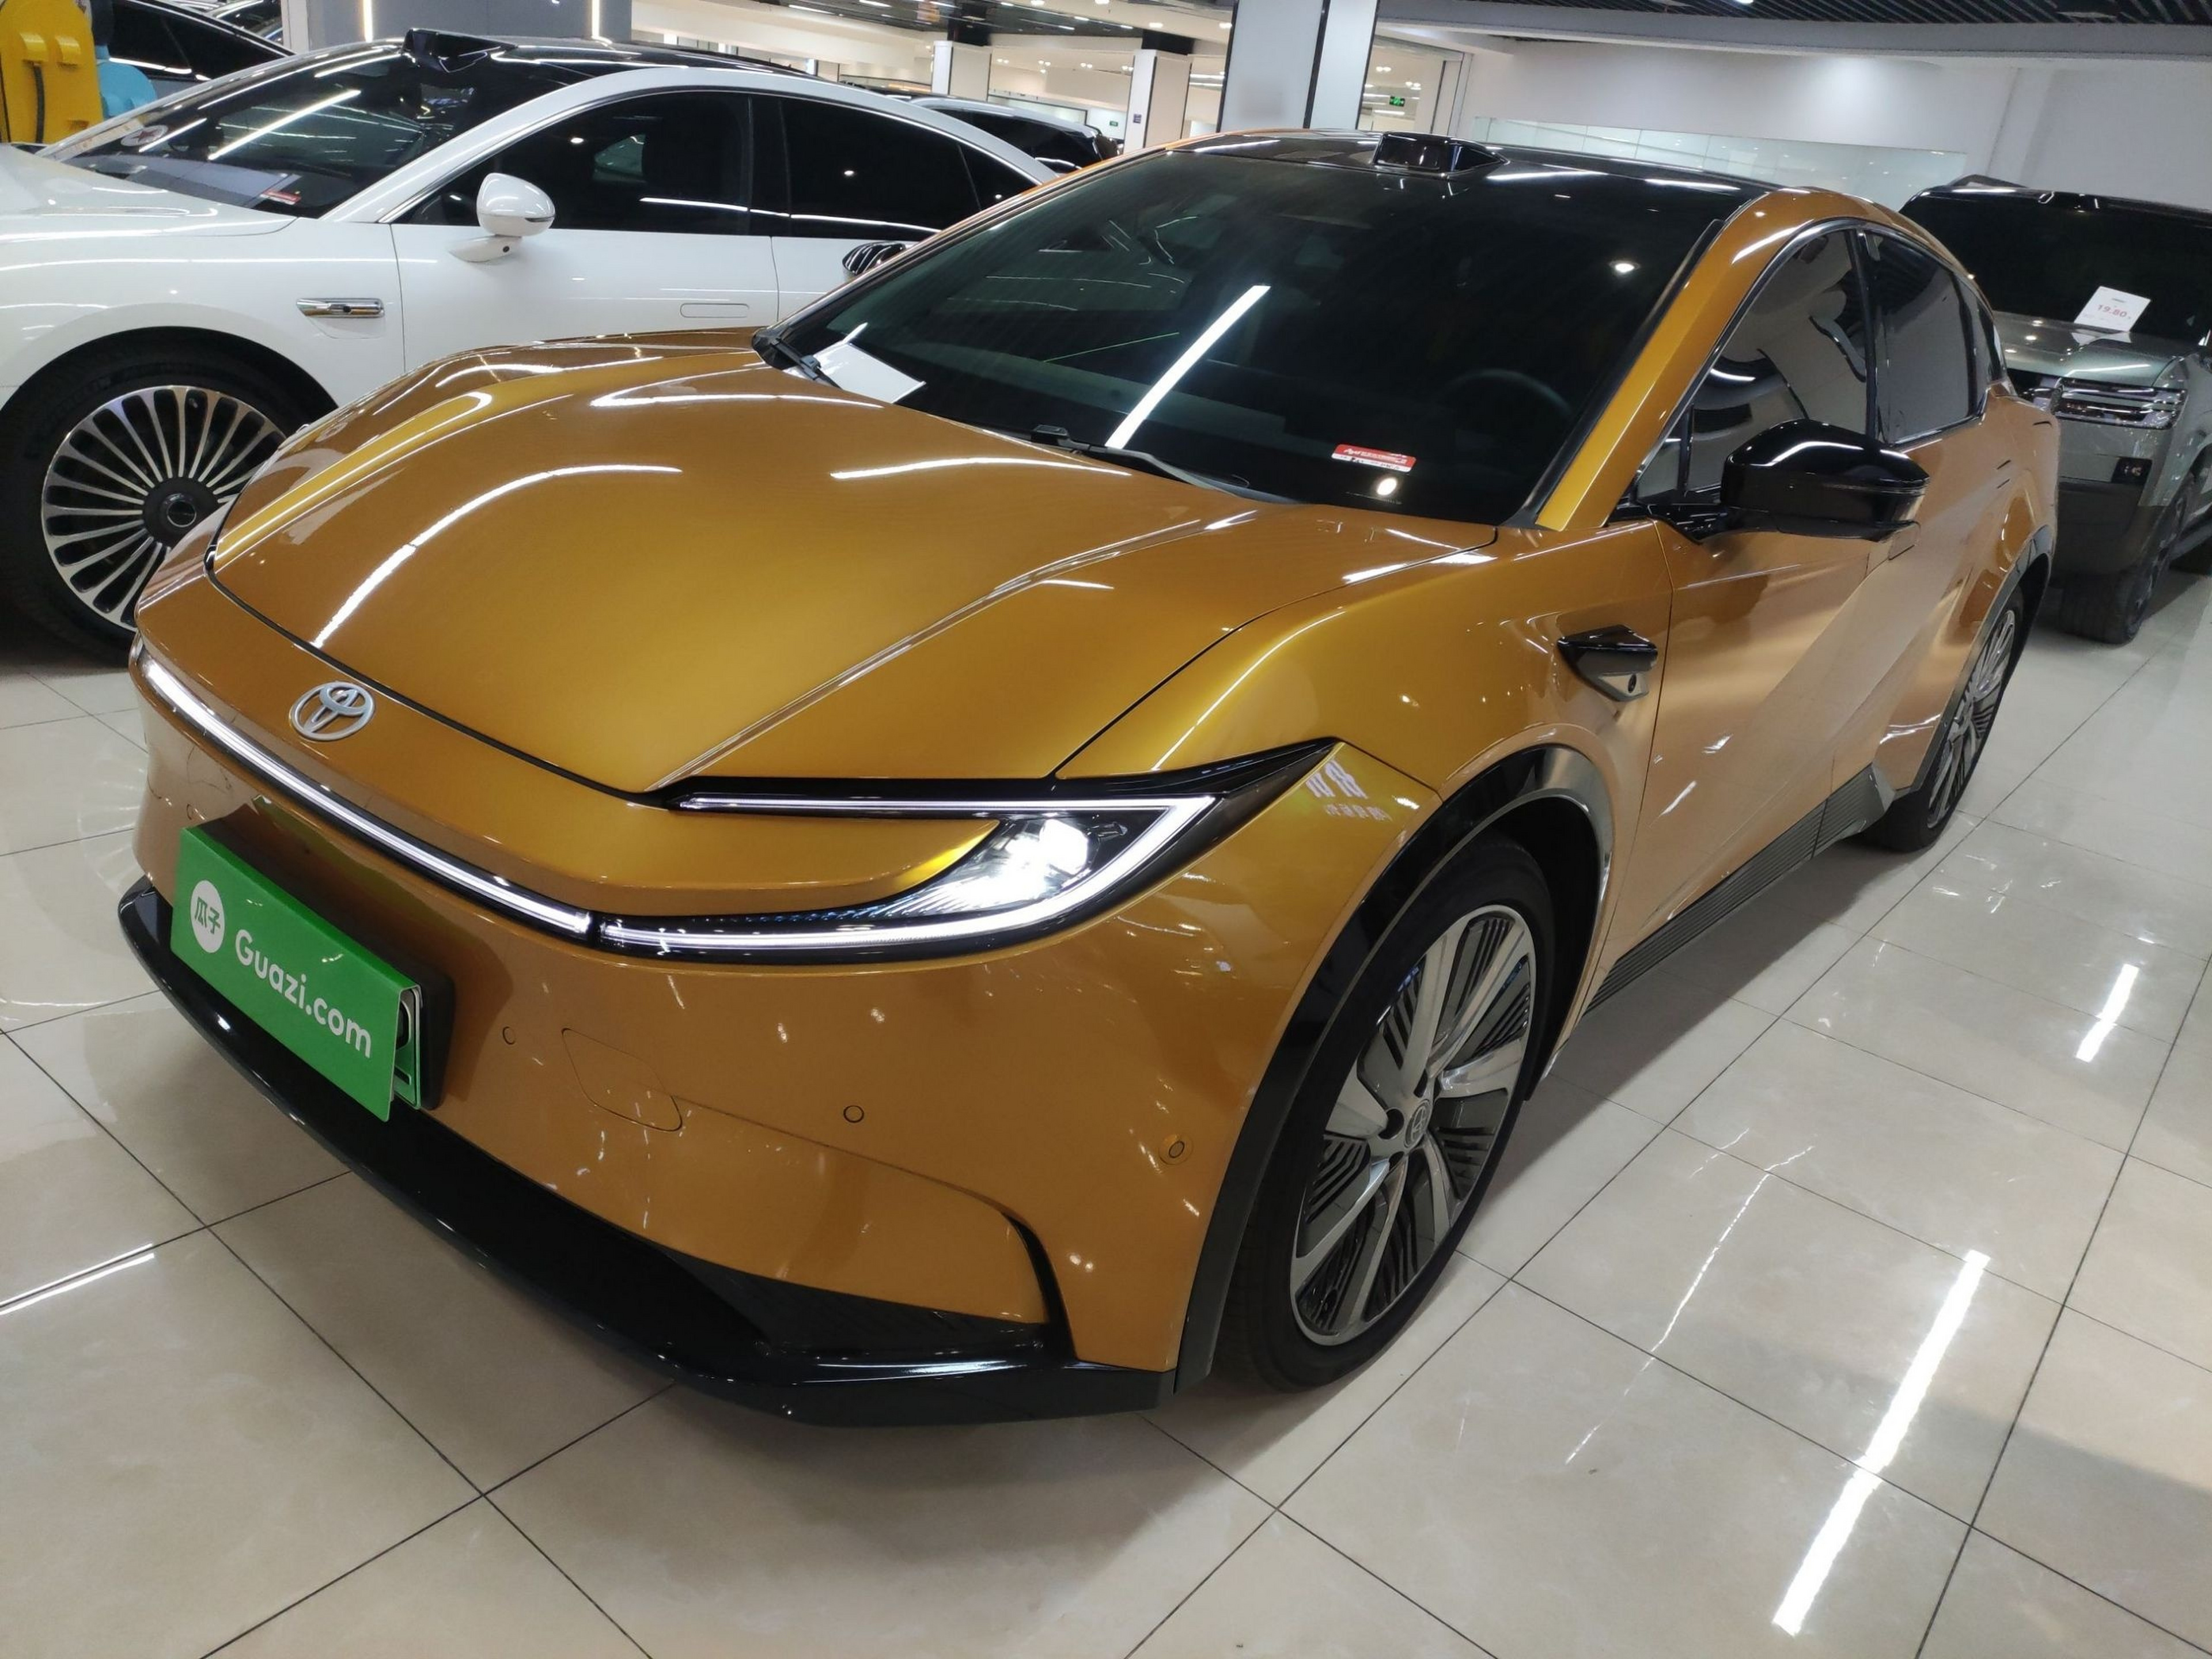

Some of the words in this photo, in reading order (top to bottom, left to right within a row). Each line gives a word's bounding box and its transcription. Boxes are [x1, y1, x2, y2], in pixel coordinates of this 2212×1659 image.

[2097, 304, 2127, 318] 19.80
[194, 896, 221, 935] 瓜子
[235, 929, 372, 1058] Guazi.com
